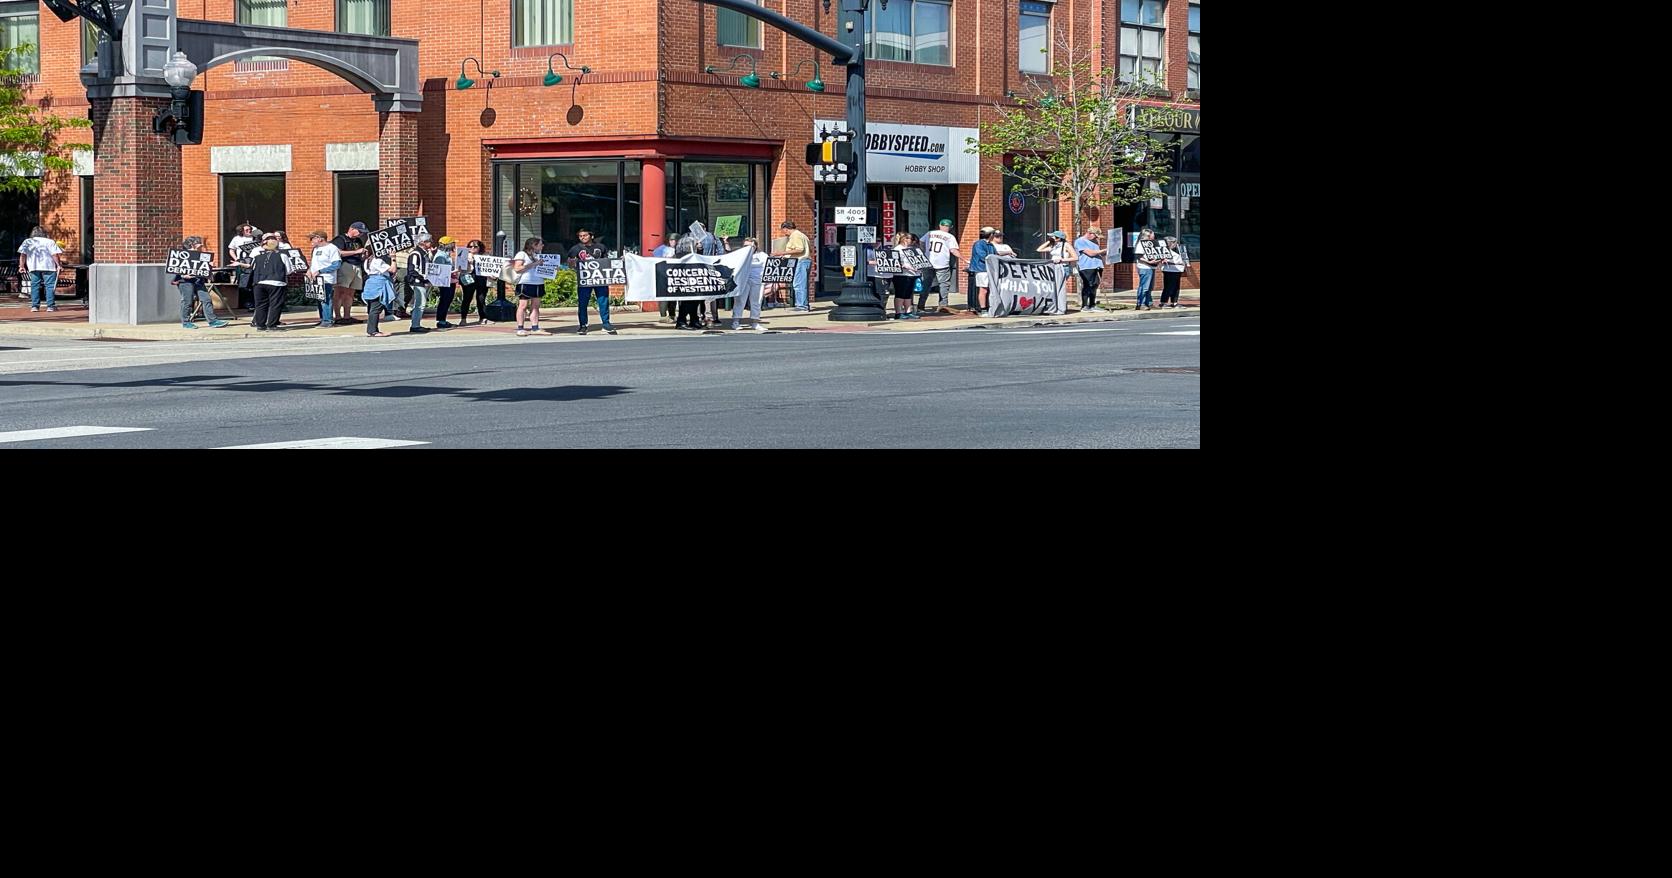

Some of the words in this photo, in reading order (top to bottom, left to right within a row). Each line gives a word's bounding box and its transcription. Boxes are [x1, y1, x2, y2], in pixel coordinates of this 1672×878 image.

[865, 133, 945, 152] OBBYSPEED.COM
[883, 203, 894, 241] HOBBY
[370, 231, 389, 242] NO
[373, 233, 411, 251] DATA
[929, 241, 943, 253] 10
[375, 241, 412, 257] CENTERS
[876, 250, 887, 258] NO
[904, 249, 915, 257] NO
[1145, 246, 1170, 254] DATA
[170, 250, 190, 260] NO
[169, 257, 210, 271] DATA
[579, 261, 600, 270] NO
[767, 259, 781, 267] NO
[877, 259, 901, 268] DATA
[909, 256, 930, 265] DATA
[167, 266, 210, 277] CENTERS
[580, 269, 625, 279] DATA
[666, 268, 722, 277] CONCERNED
[764, 267, 794, 276] DATA
[998, 259, 1055, 282] DEFEND
[580, 278, 626, 286] CENTERS
[667, 277, 725, 286] RESIDENTS
[998, 279, 1029, 293] WHAT
[1032, 280, 1054, 294] YOU
[305, 284, 324, 294] DATA
[679, 285, 716, 293] WESTERN
